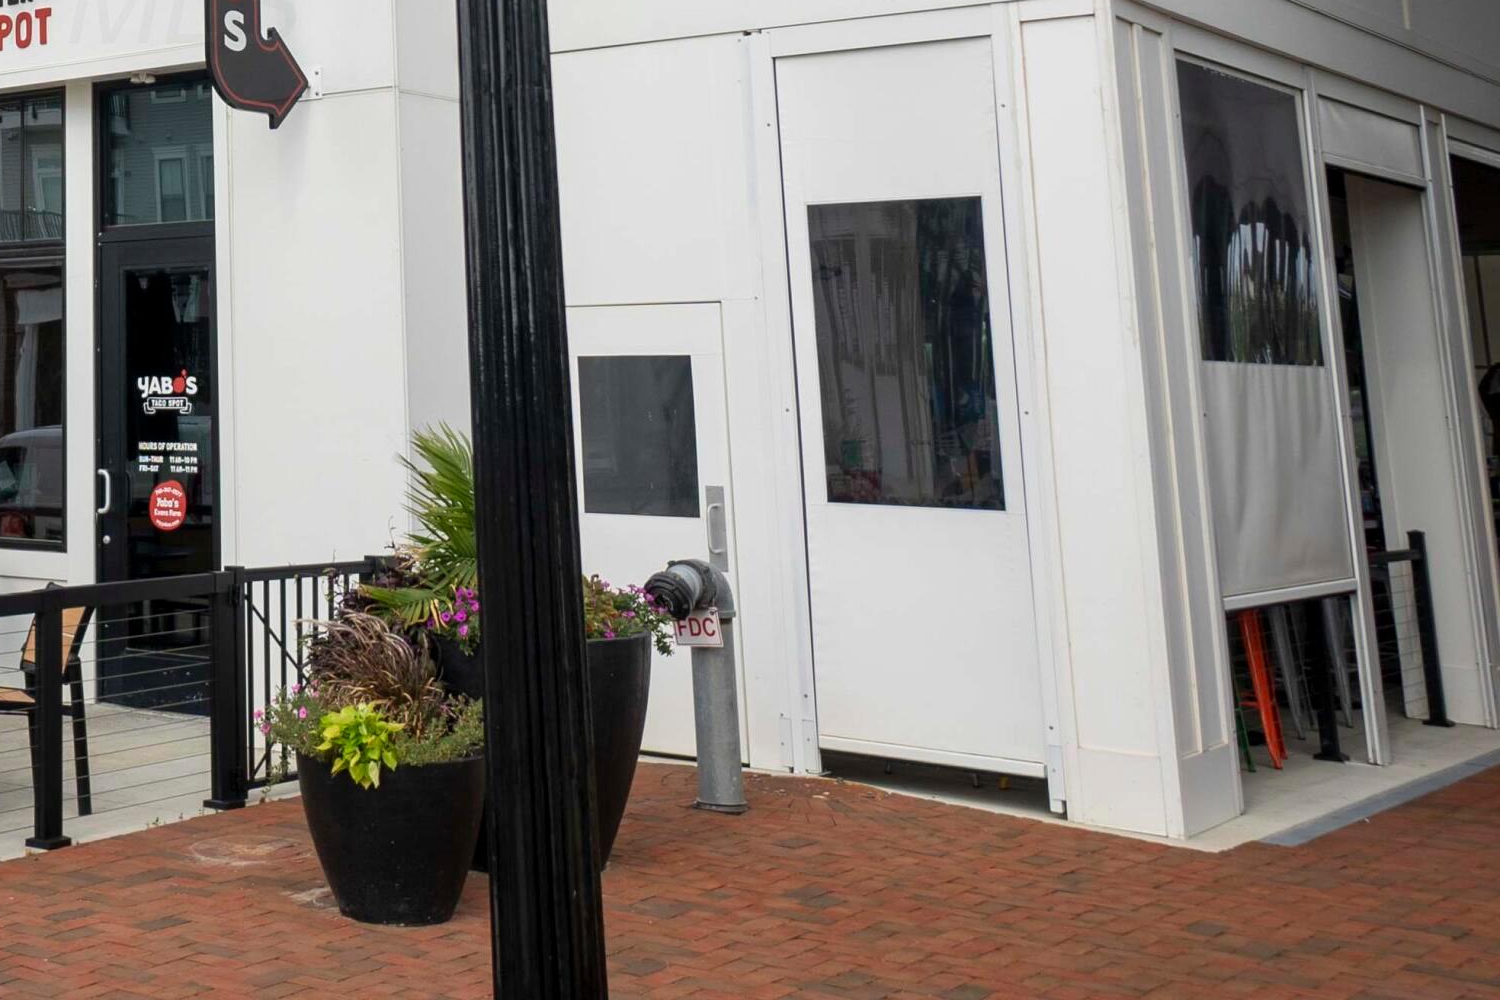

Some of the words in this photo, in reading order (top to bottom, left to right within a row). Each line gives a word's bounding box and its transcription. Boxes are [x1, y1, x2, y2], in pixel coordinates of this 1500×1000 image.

[151, 399, 167, 407] TACO
[168, 399, 184, 407] SPOT
[138, 442, 157, 450] HOURS
[166, 442, 198, 452] OPERATION
[677, 616, 716, 637] FDC
